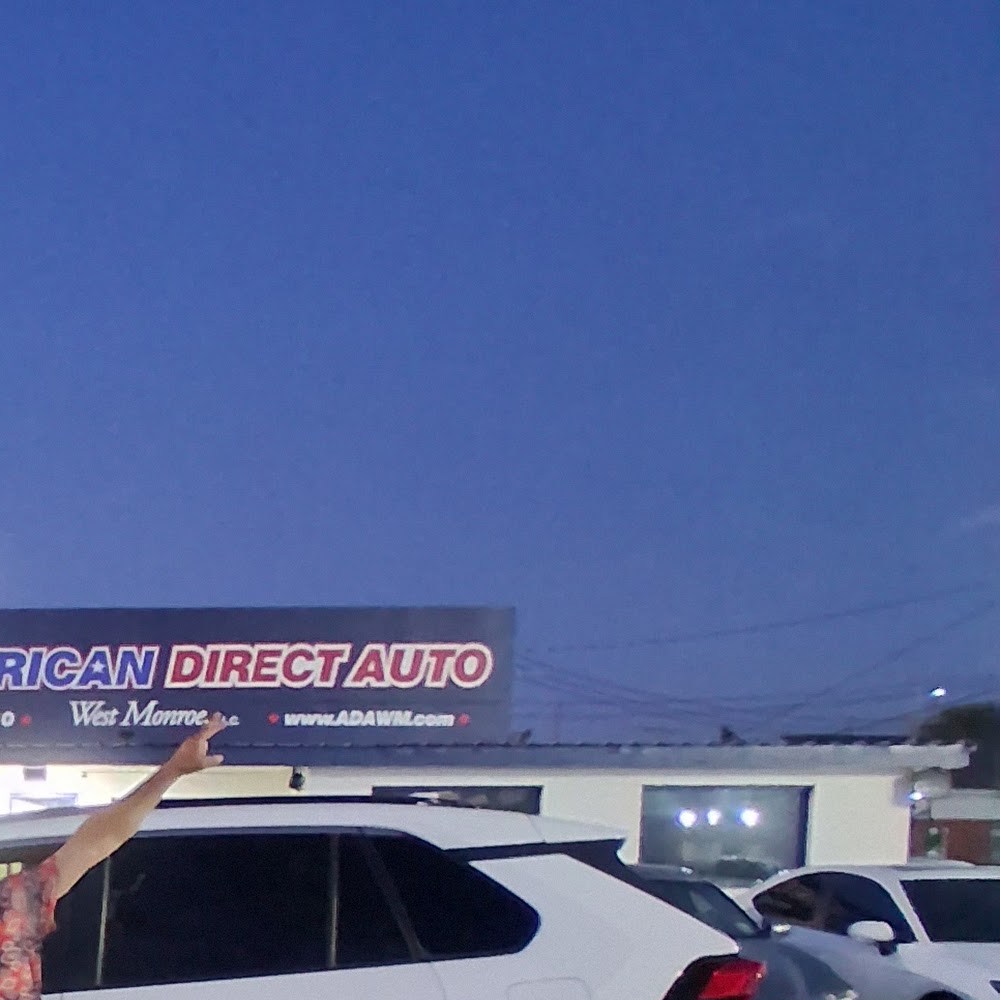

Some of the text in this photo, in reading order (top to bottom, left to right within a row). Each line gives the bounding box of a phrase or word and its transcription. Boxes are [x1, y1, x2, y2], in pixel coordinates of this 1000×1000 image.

[164, 642, 351, 689] DIRECT
[343, 642, 494, 689] AUTO
[69, 700, 120, 726] West
[284, 710, 455, 727] www.ADAWM.com
